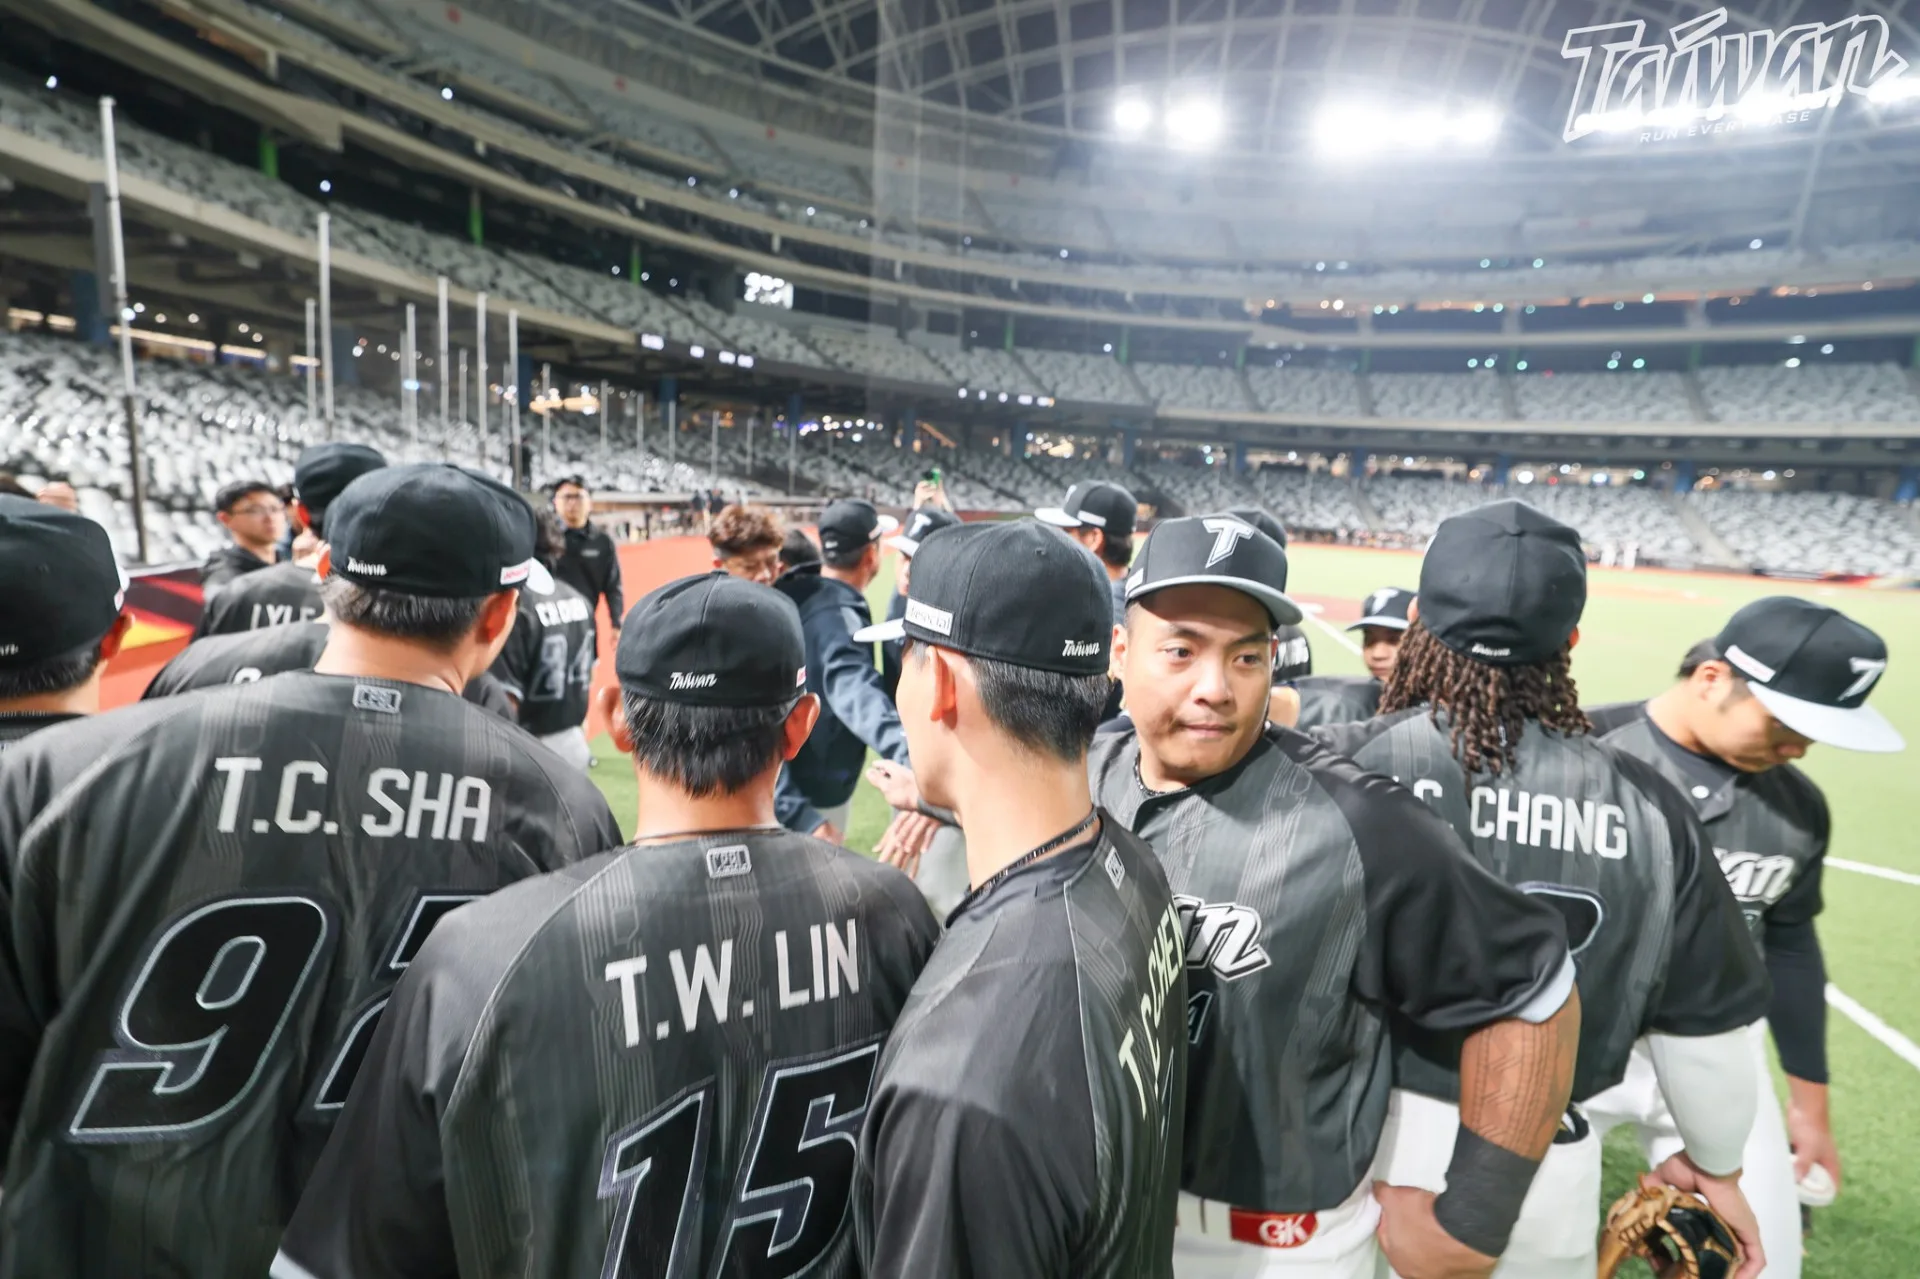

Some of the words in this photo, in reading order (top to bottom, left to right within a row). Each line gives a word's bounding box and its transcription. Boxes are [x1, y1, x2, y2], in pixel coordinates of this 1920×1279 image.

[1202, 518, 1254, 569] T
[214, 756, 339, 834] T.C.
[360, 767, 492, 842] SHA
[1470, 785, 1628, 861] CHANG
[604, 938, 755, 1049] T.W.
[774, 918, 860, 1011] LIN
